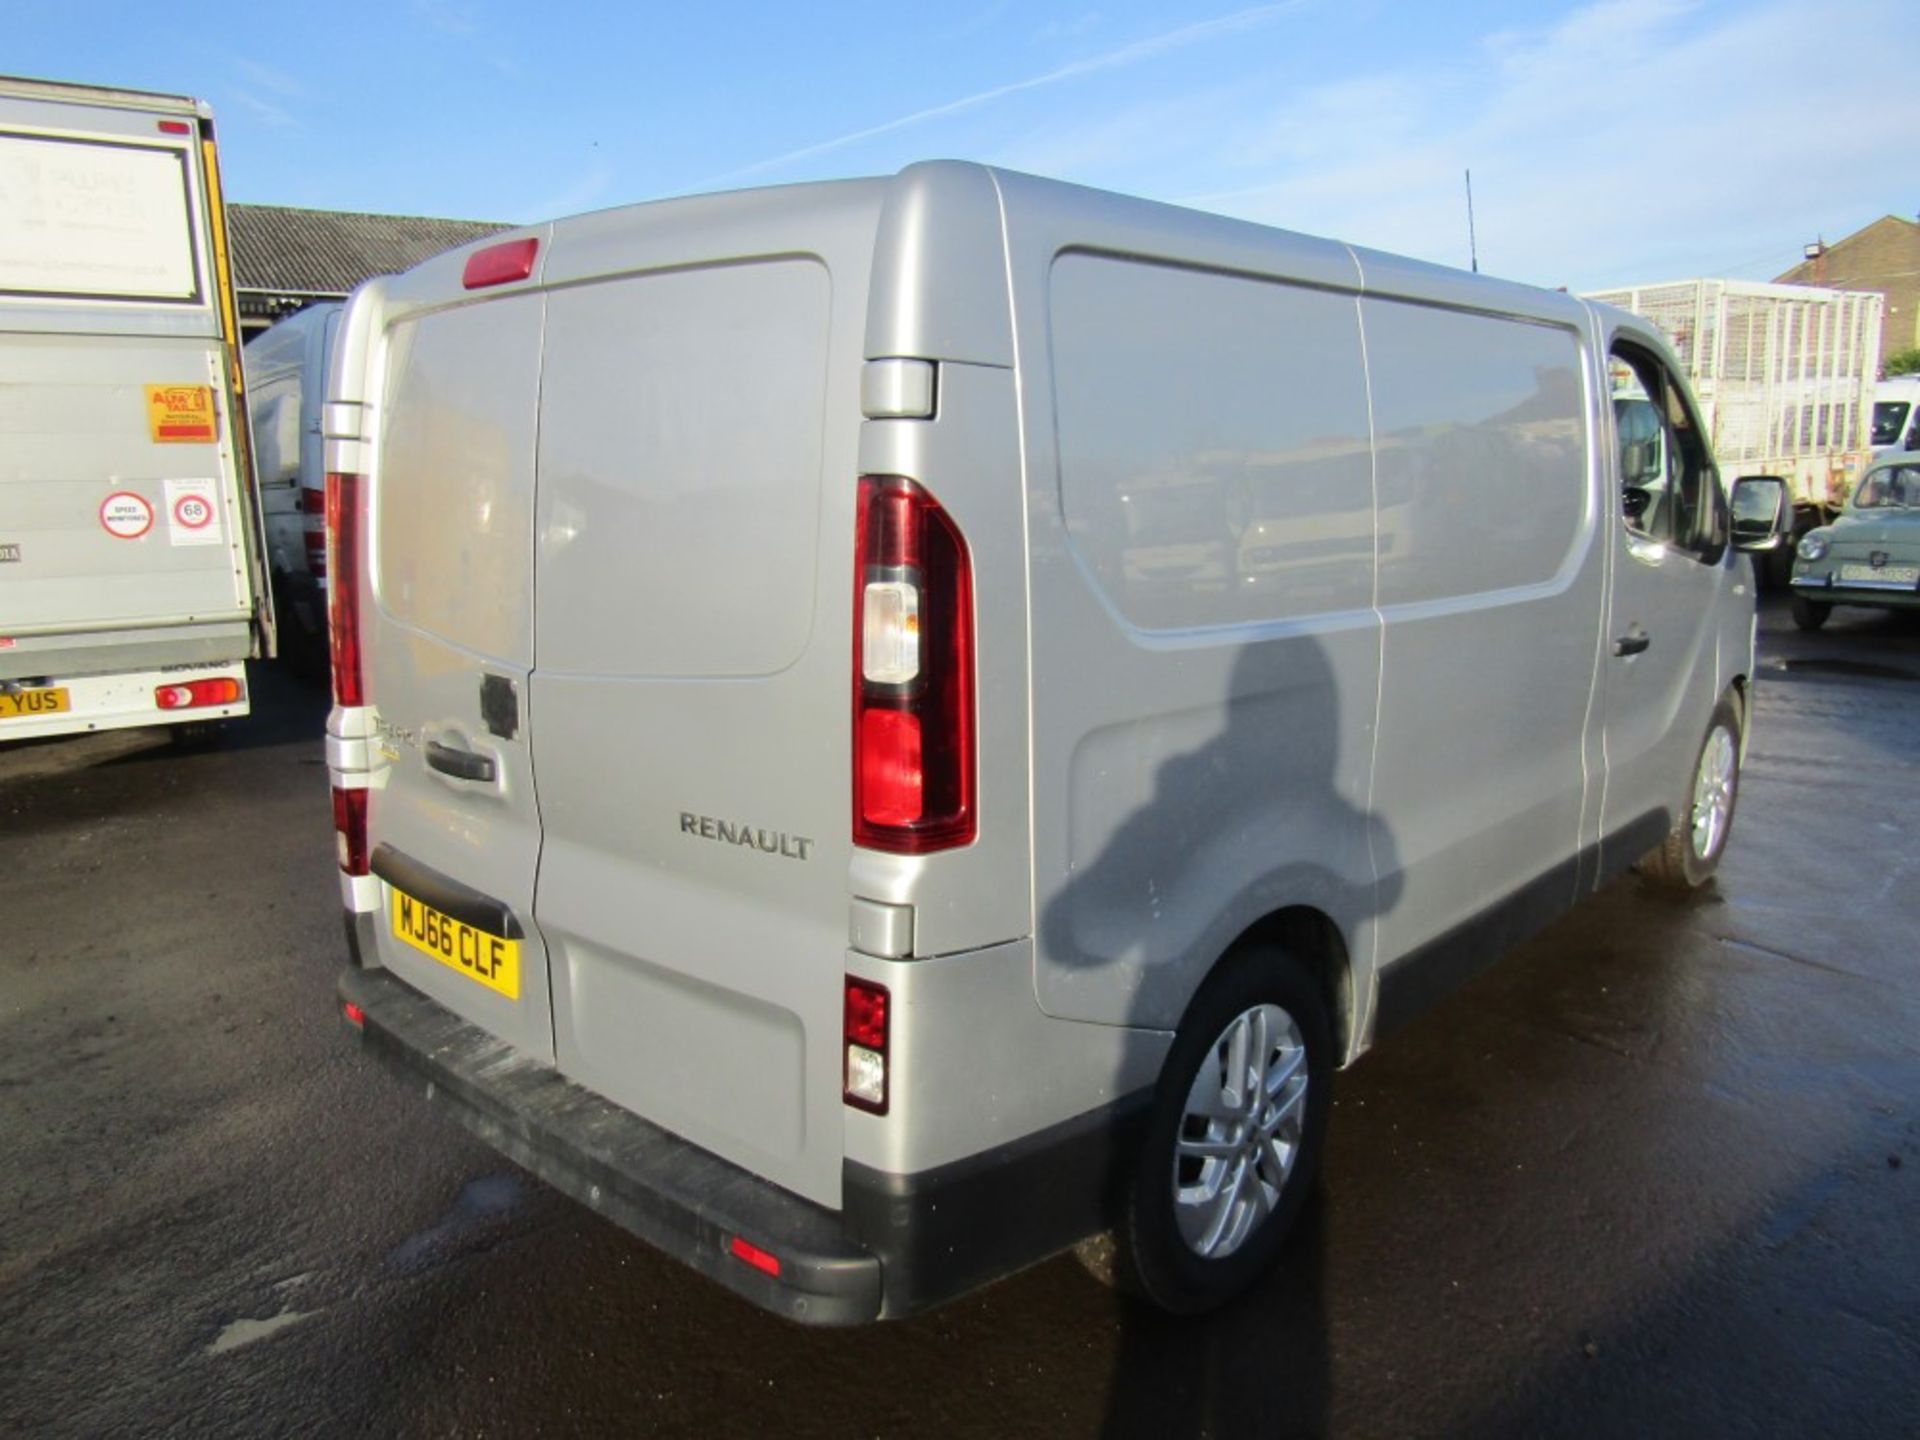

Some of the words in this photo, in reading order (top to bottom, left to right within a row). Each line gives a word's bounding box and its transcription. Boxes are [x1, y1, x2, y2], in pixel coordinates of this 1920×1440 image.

[183, 504, 203, 516] 68
[11, 692, 58, 712] YUS
[679, 811, 814, 861] RENAULT
[400, 894, 453, 957] MJ66
[459, 924, 505, 981] CLF
